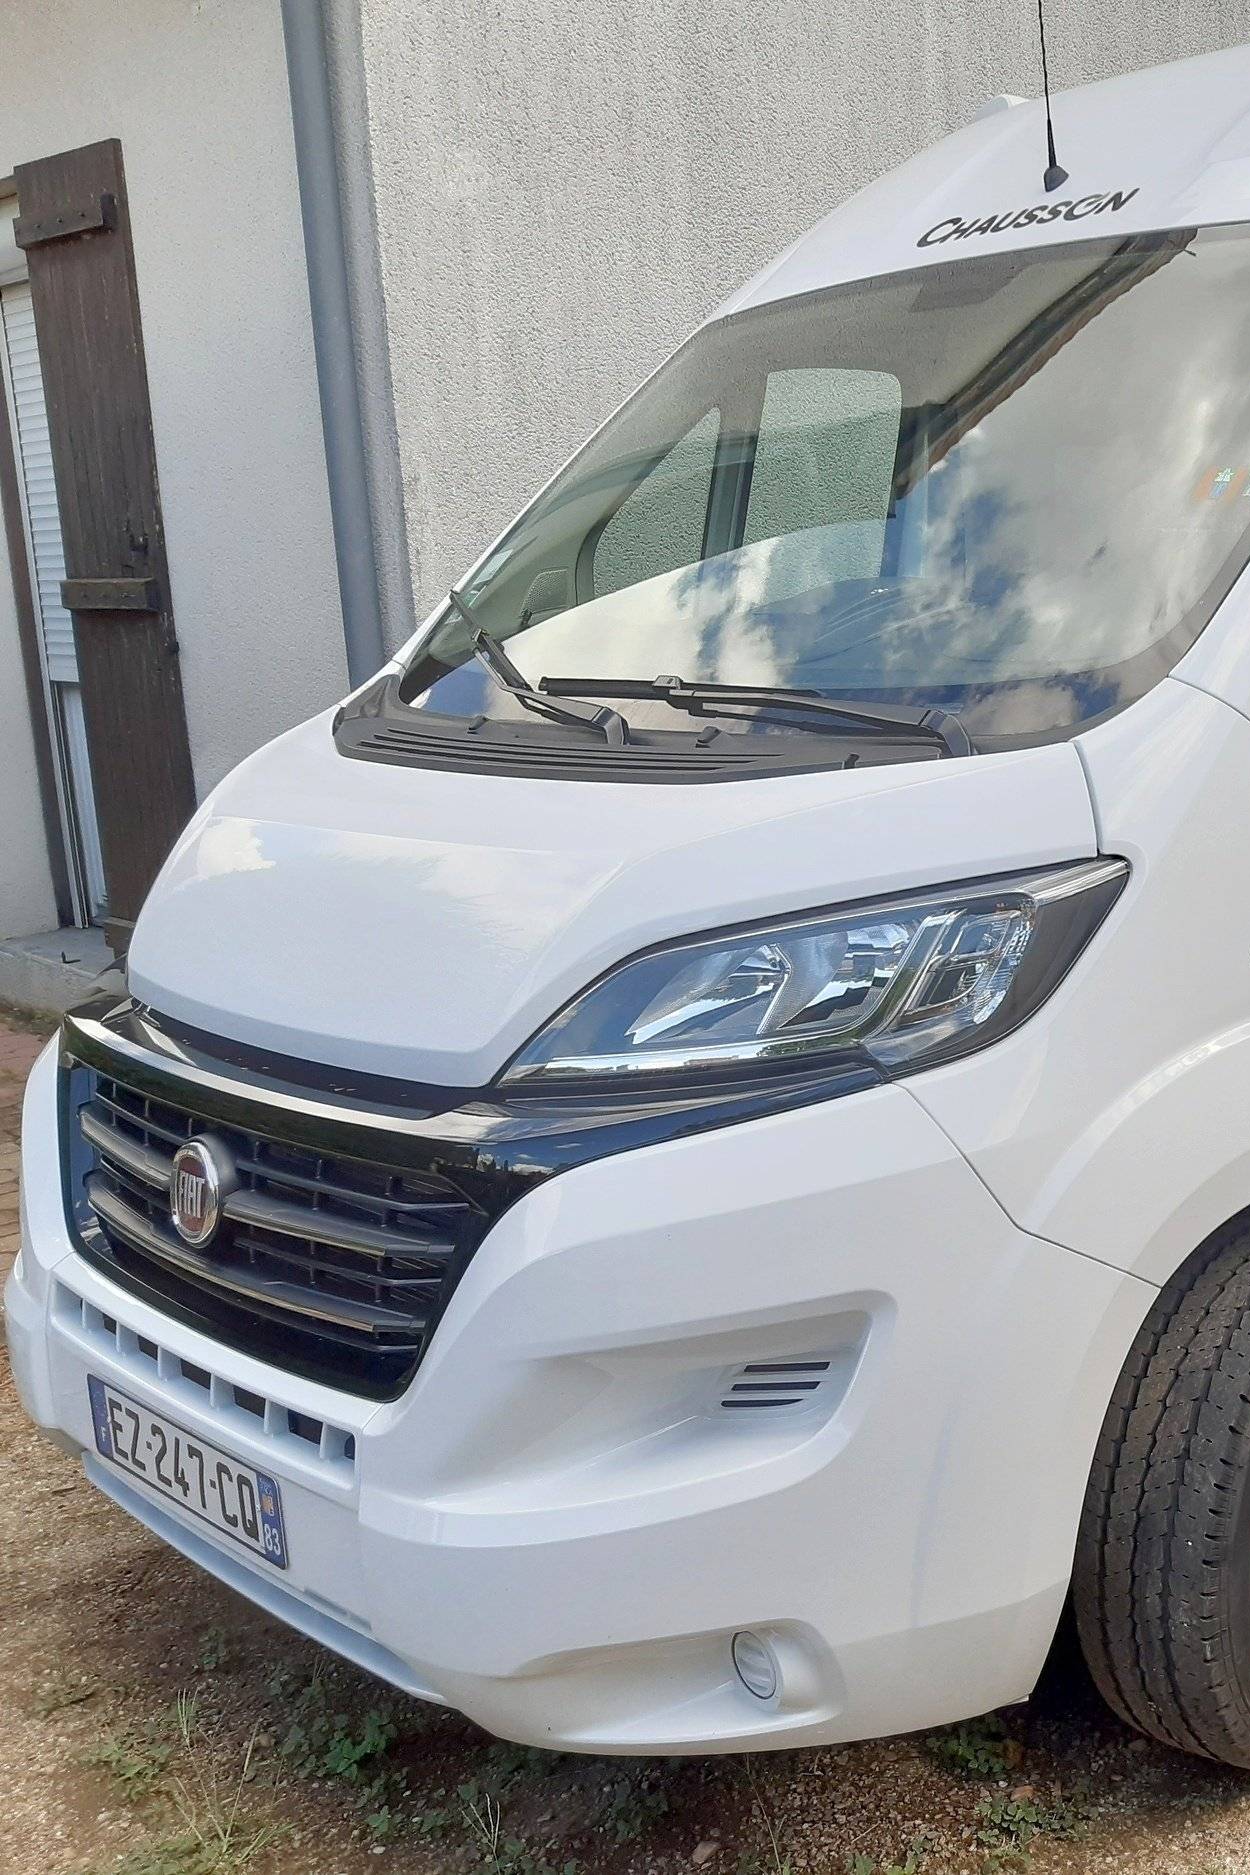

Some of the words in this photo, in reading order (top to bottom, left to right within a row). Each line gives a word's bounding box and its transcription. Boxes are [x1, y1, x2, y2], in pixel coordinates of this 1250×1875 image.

[916, 187, 1140, 248] CHAUSSON
[179, 1169, 206, 1219] FIAT
[264, 1523, 281, 1556] 83
